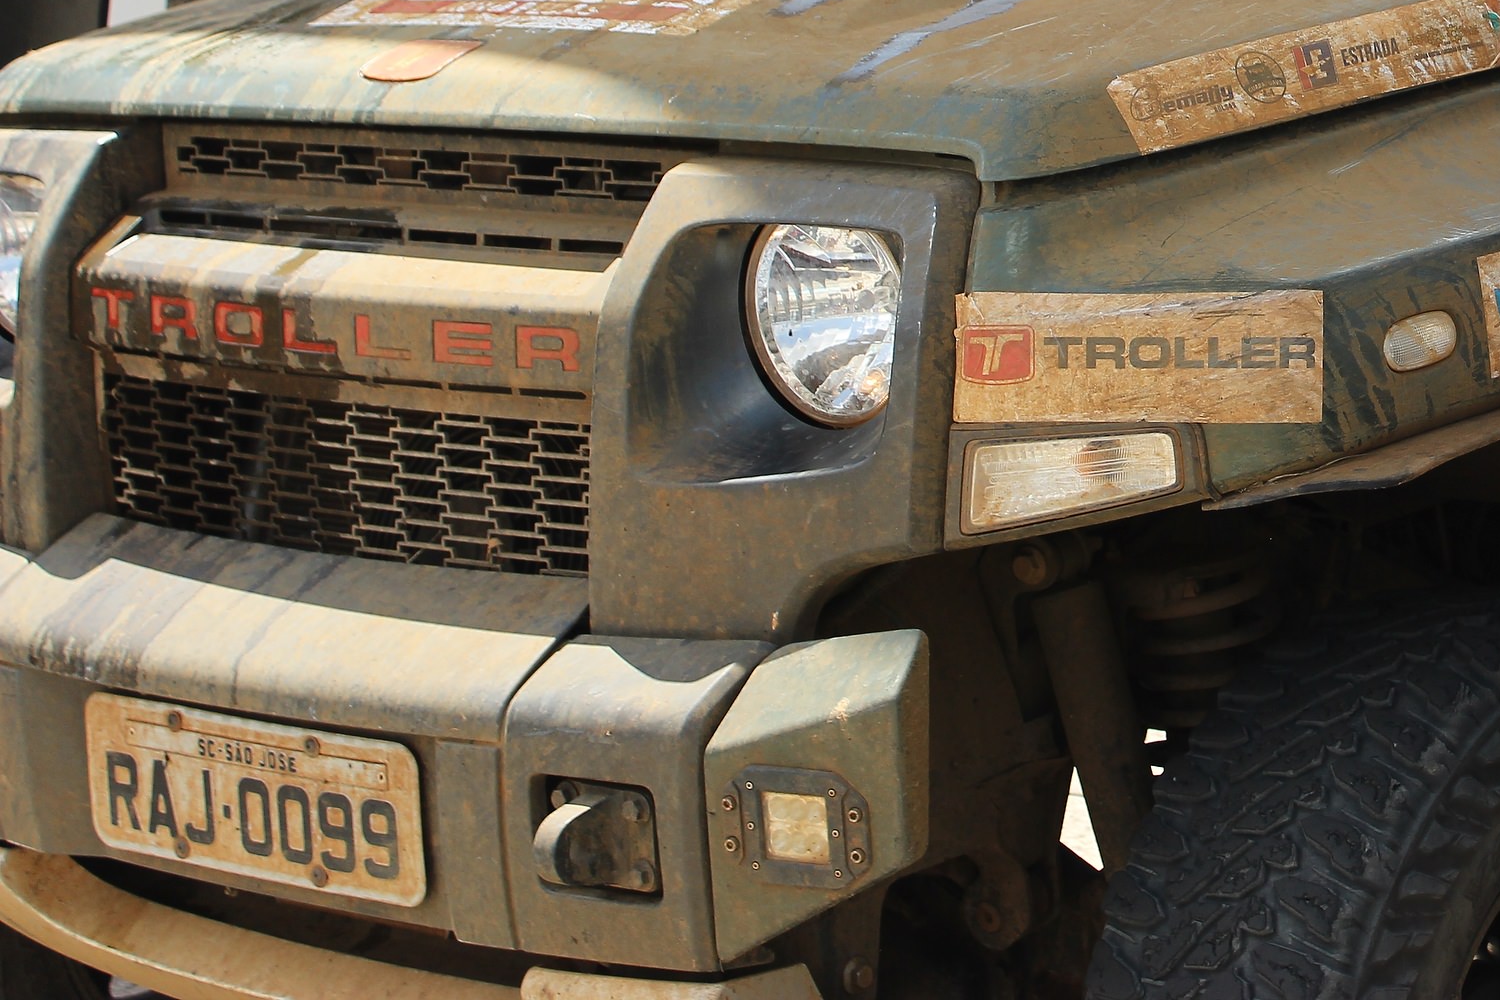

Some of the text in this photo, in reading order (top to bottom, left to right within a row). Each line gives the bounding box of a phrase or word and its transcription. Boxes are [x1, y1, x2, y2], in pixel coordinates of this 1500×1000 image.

[1340, 37, 1401, 67] ESTRADA
[91, 286, 581, 372] TROLLER
[1044, 336, 1316, 369] TROLLER
